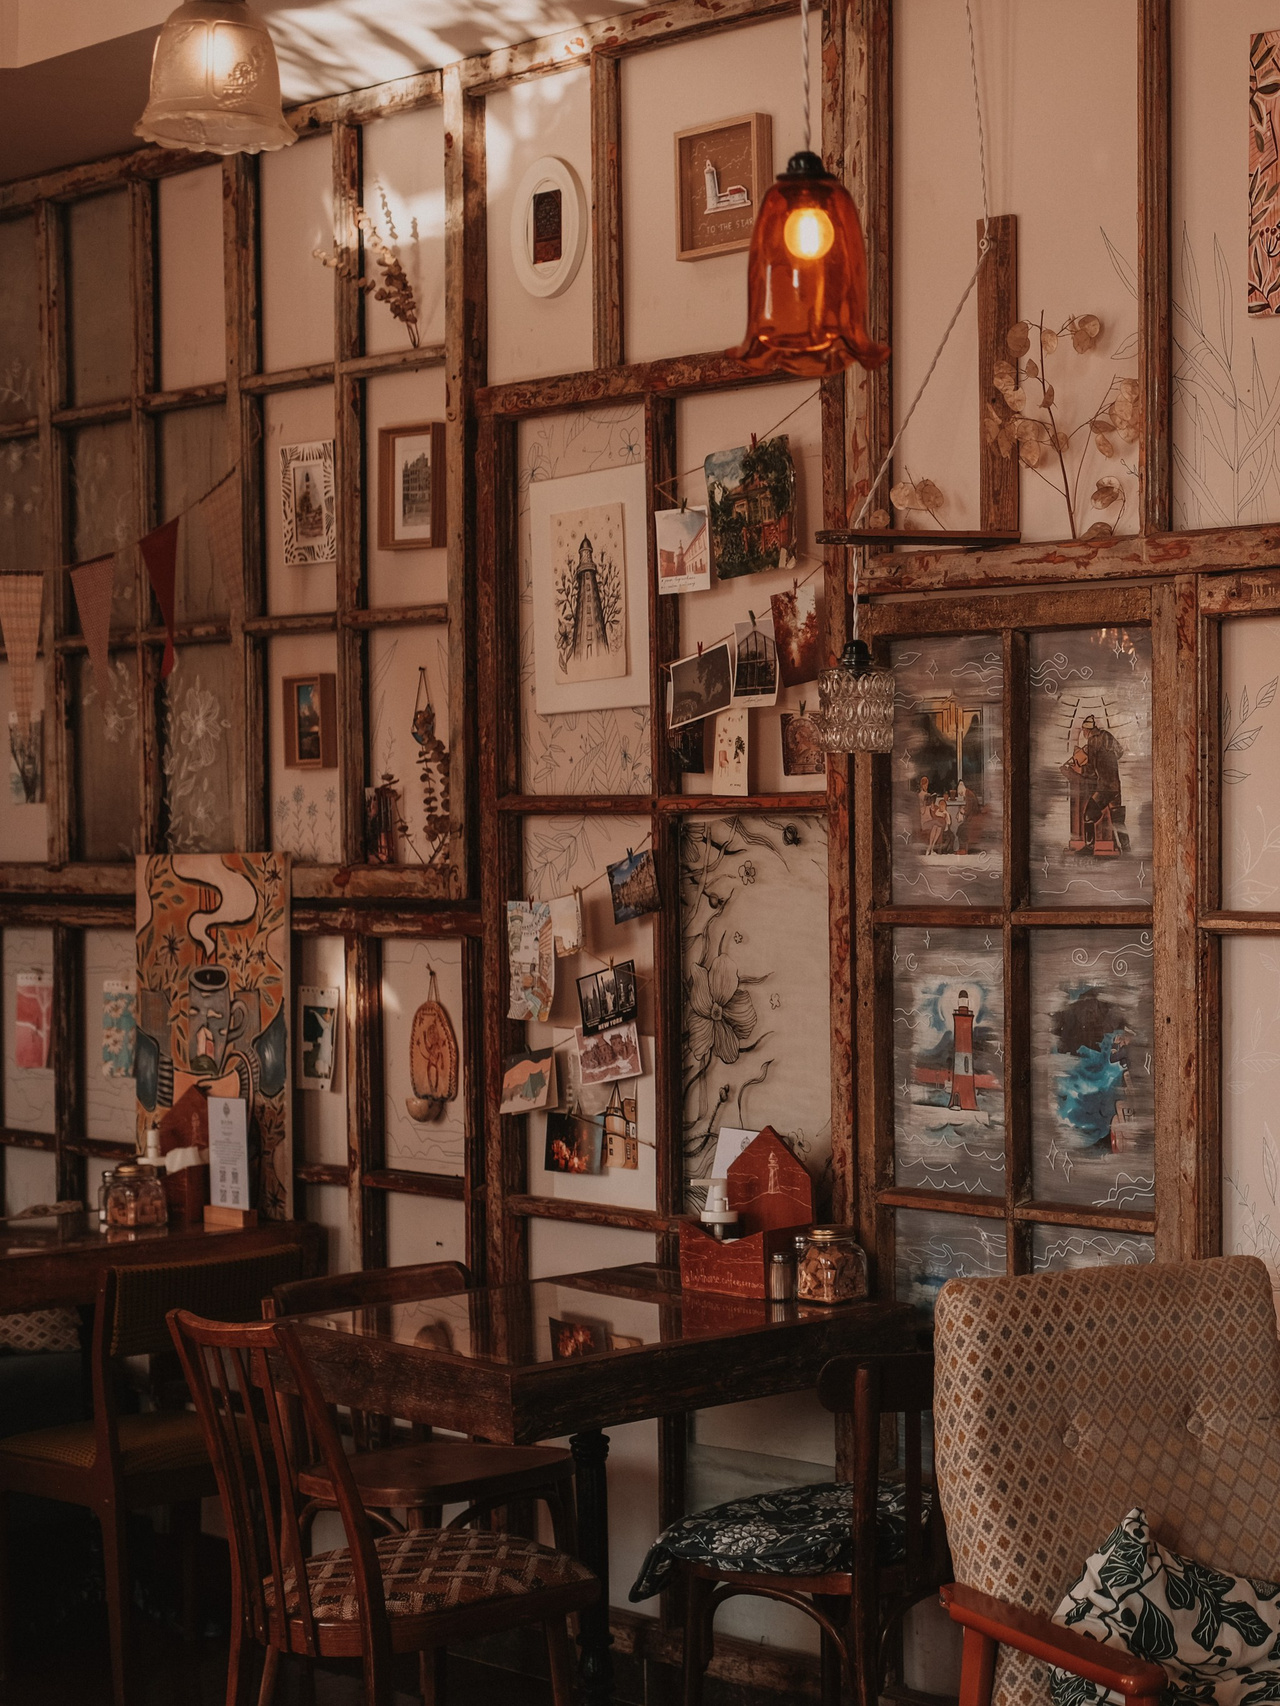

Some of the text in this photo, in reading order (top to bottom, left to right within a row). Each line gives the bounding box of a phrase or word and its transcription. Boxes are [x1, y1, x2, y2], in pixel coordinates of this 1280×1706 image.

[719, 221, 732, 231] THE
[598, 1022, 609, 1030] NEW
[610, 1017, 623, 1027] YORK
